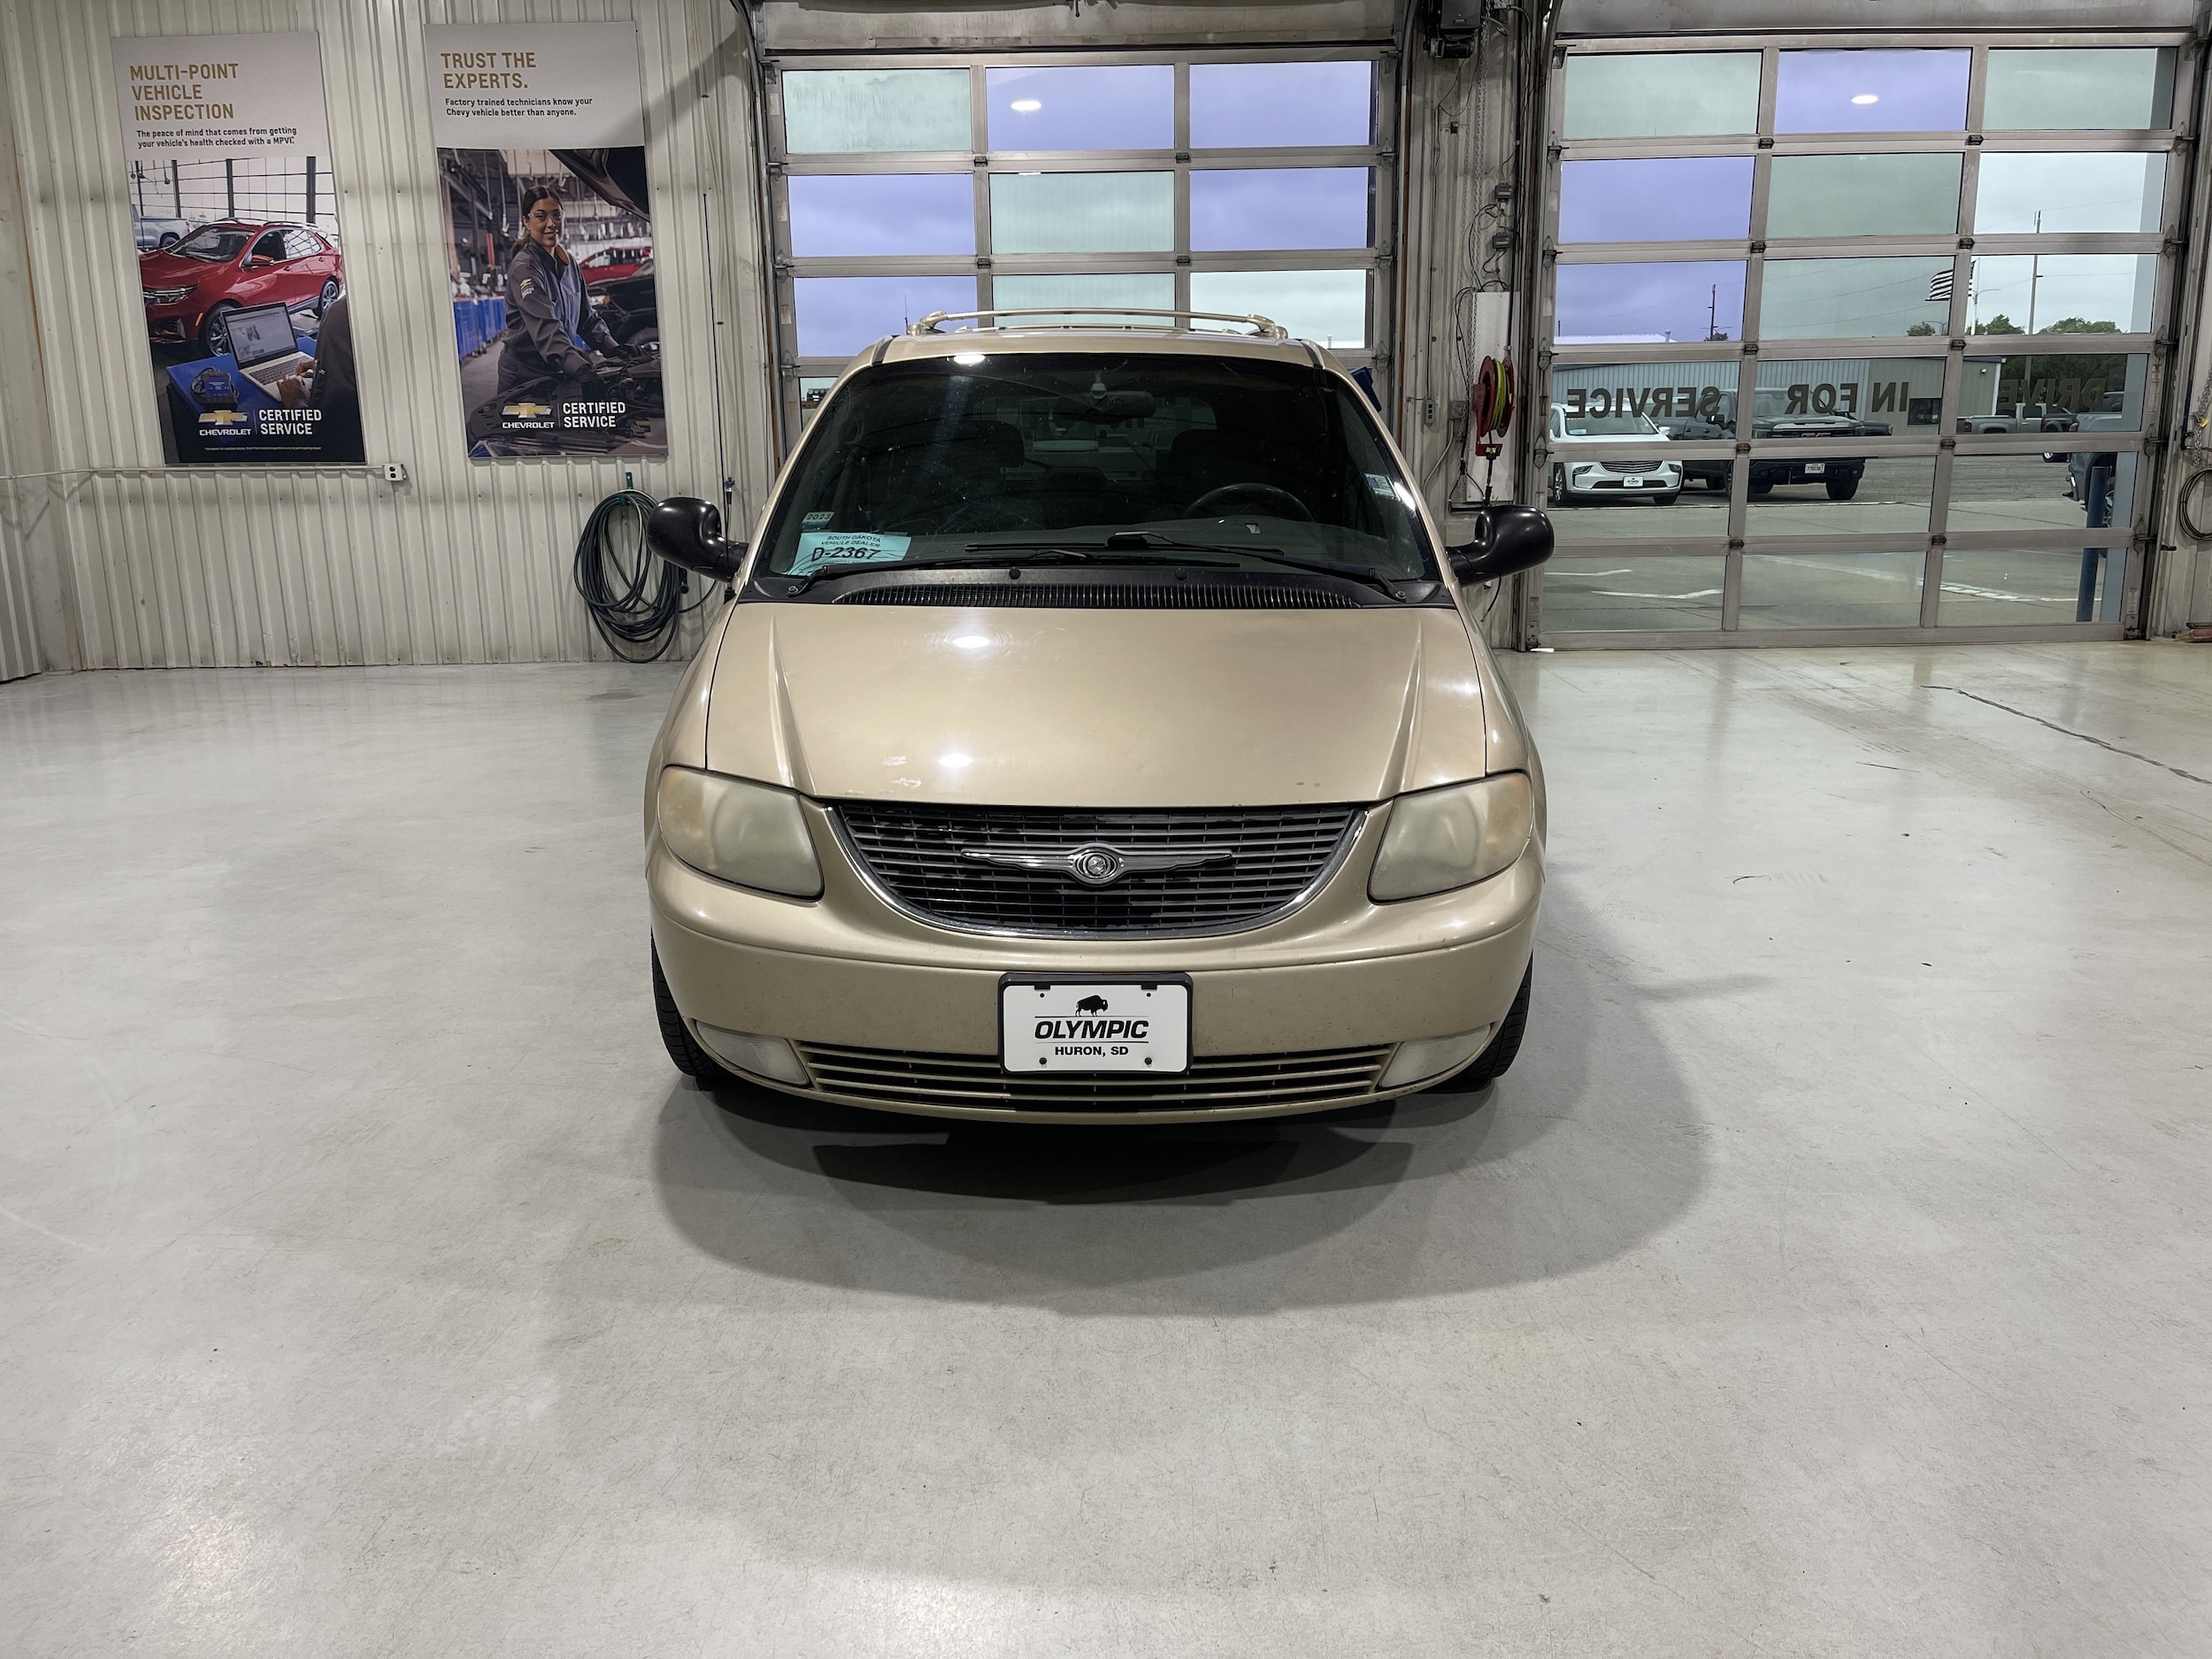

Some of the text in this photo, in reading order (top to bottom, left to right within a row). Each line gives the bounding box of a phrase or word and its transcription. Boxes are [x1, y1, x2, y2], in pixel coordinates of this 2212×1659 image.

[441, 52, 536, 68] TRUST THE
[130, 63, 238, 81] MULTI-POINT
[443, 73, 528, 89] EXPERTS.
[131, 84, 203, 101] VEHICLE
[445, 98, 475, 107] Factory
[507, 97, 551, 106] technicians
[575, 98, 592, 107] your
[134, 104, 234, 120] INSPECTION
[152, 130, 173, 139] peace
[269, 127, 297, 135] getting
[157, 139, 188, 148] vehicle's
[215, 137, 246, 146] checked
[563, 402, 626, 414] CERTIFIED
[258, 409, 322, 421] CERTIFIED
[564, 415, 617, 428] SERVICE
[260, 423, 312, 435] SERVICE
[850, 540, 881, 549] DEALER
[811, 547, 881, 562] D-2367
[1034, 1020, 1149, 1040] OLYMPIC
[1055, 1046, 1129, 1057] HURON, SD
